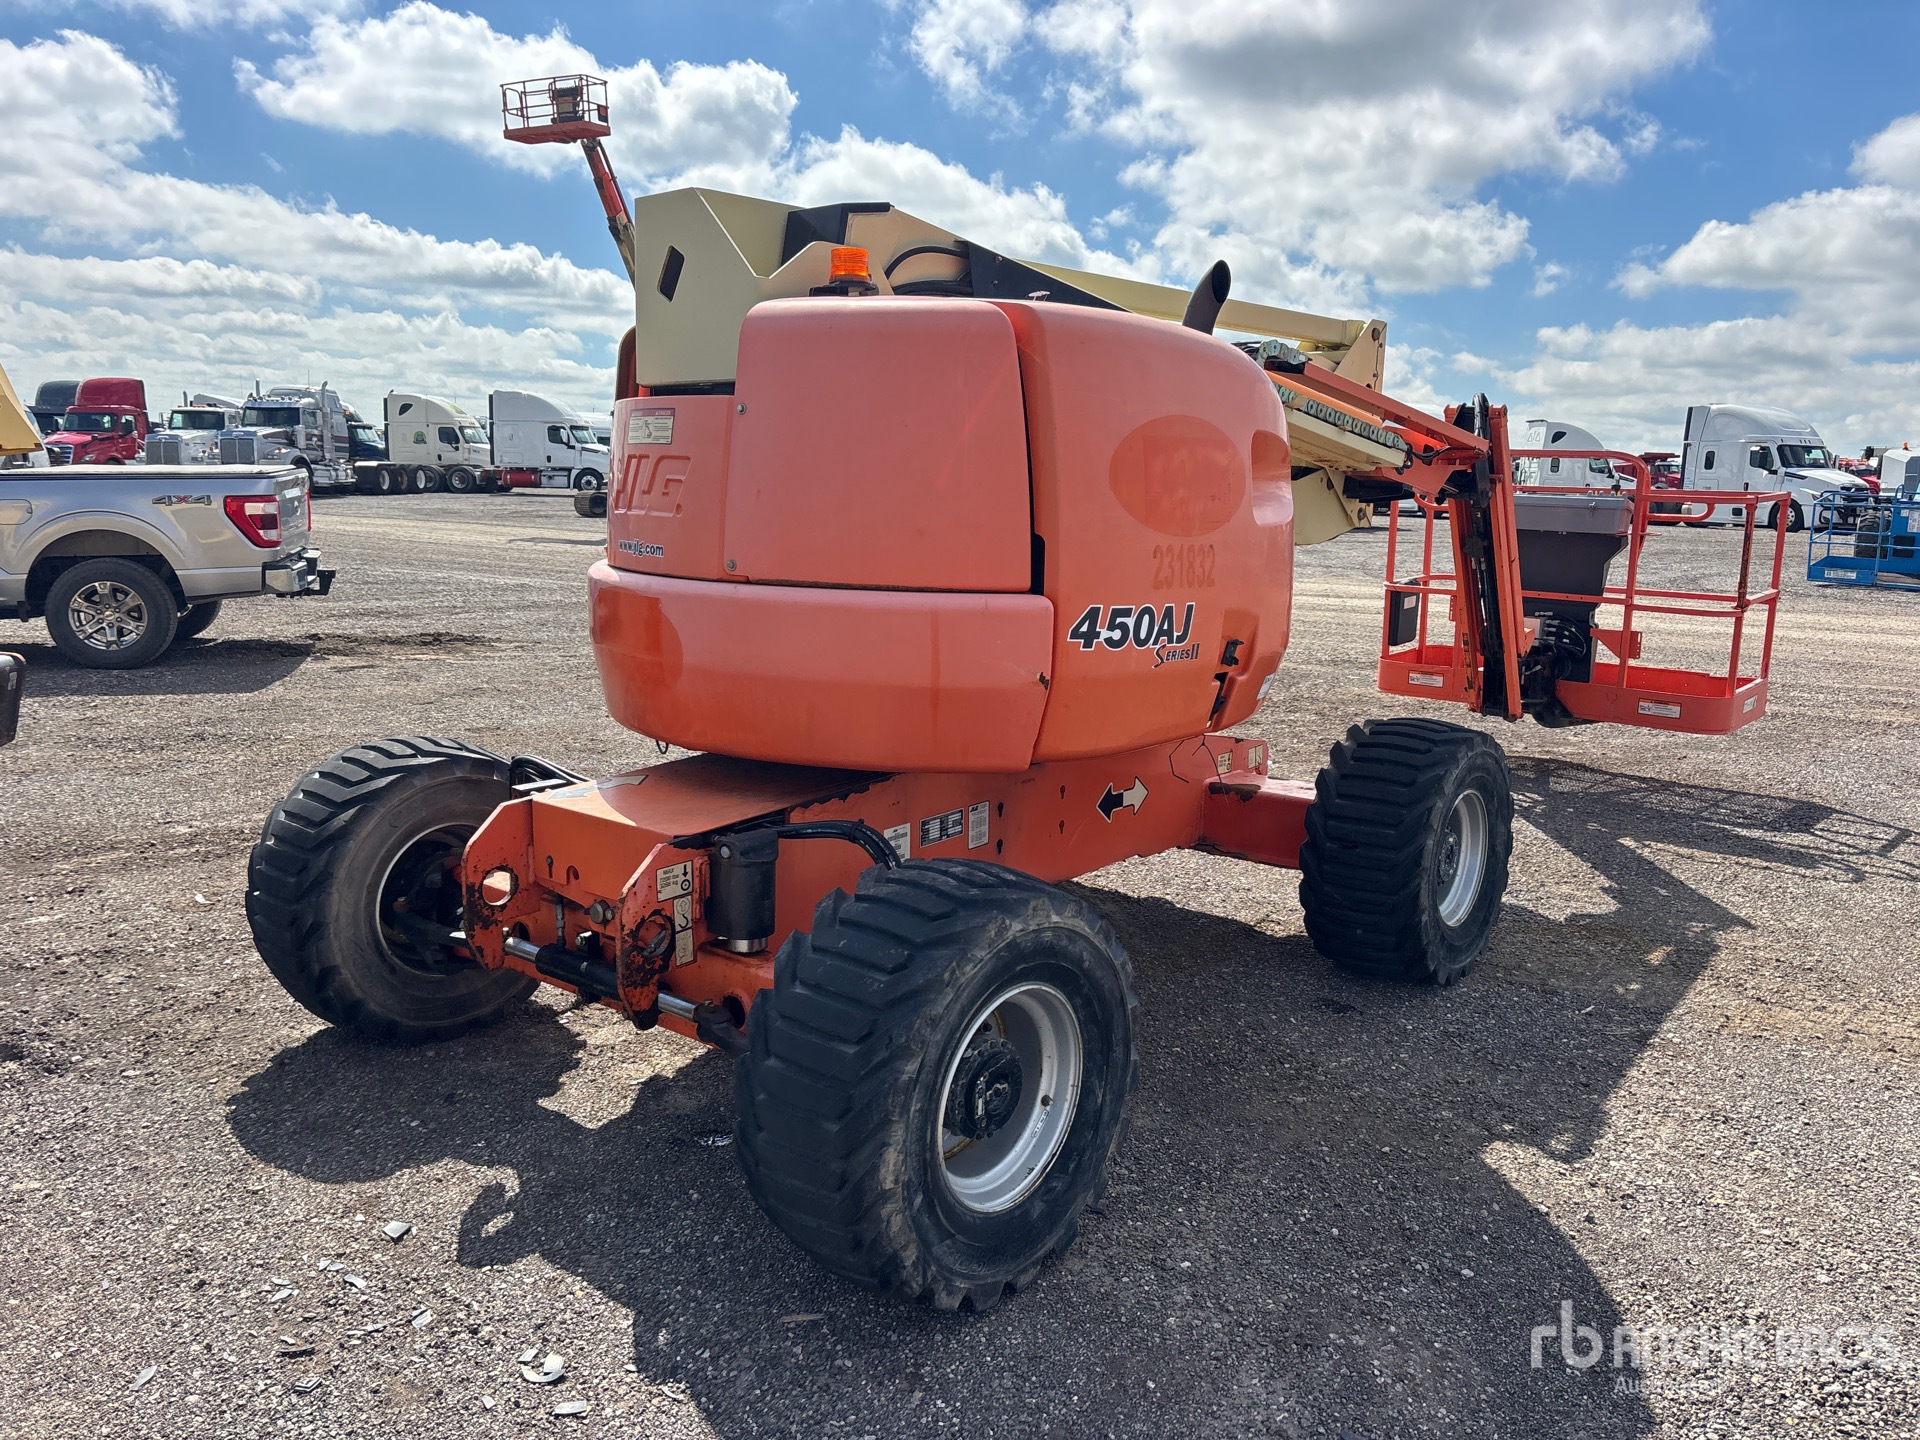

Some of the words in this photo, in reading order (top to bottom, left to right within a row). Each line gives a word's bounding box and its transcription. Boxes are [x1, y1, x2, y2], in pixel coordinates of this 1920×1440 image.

[618, 538, 664, 557] www.jlg.com
[1152, 543, 1216, 590] 231832
[1067, 602, 1195, 651] 450AJ
